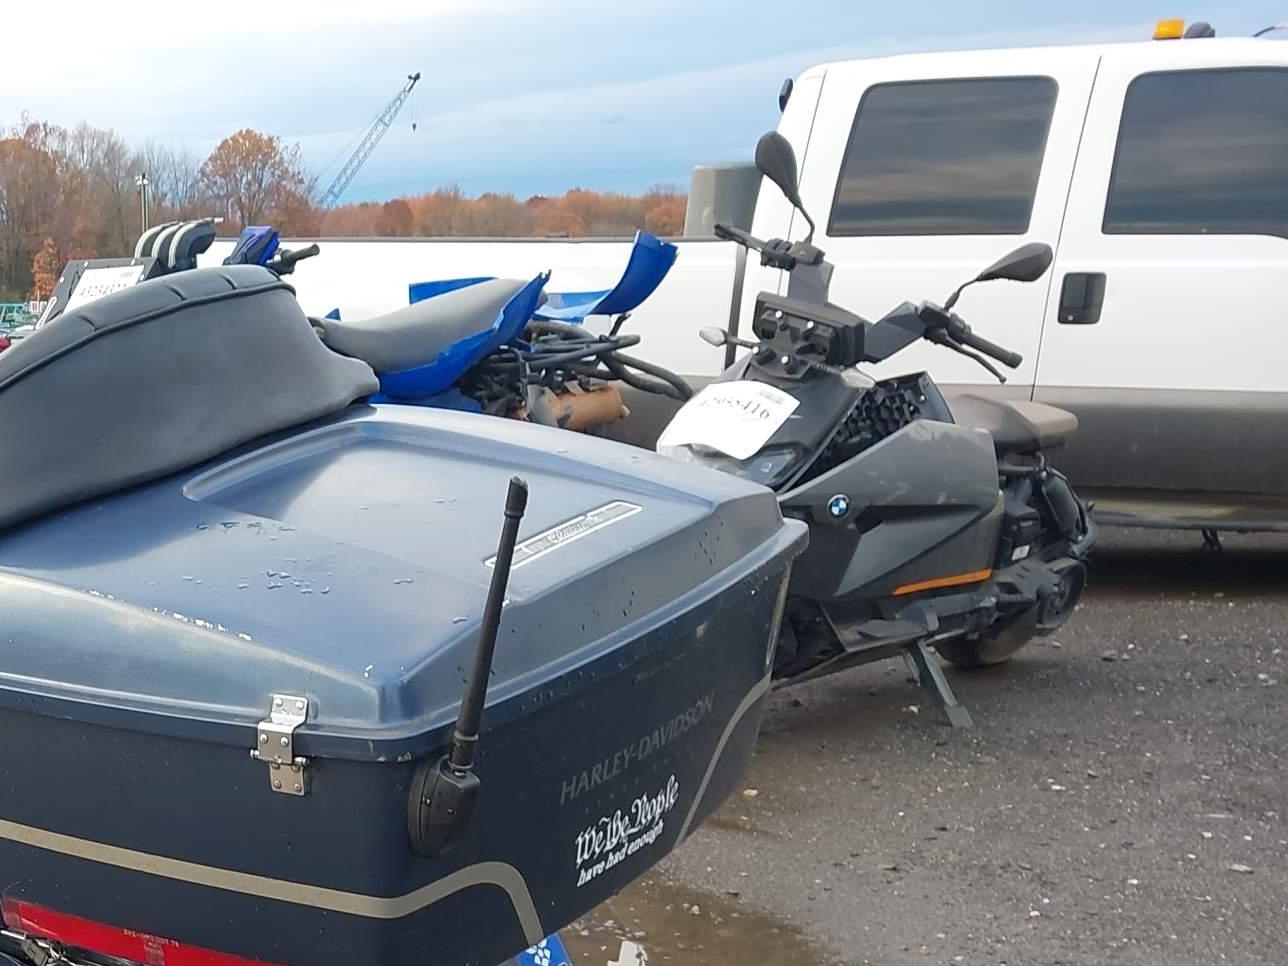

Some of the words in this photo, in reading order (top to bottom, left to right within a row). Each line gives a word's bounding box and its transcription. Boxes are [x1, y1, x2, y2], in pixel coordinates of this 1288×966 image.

[561, 693, 715, 804] HARLEY-DAVIDSON
[576, 861, 605, 888] have
[605, 843, 627, 870] had
[627, 819, 664, 856] enough
